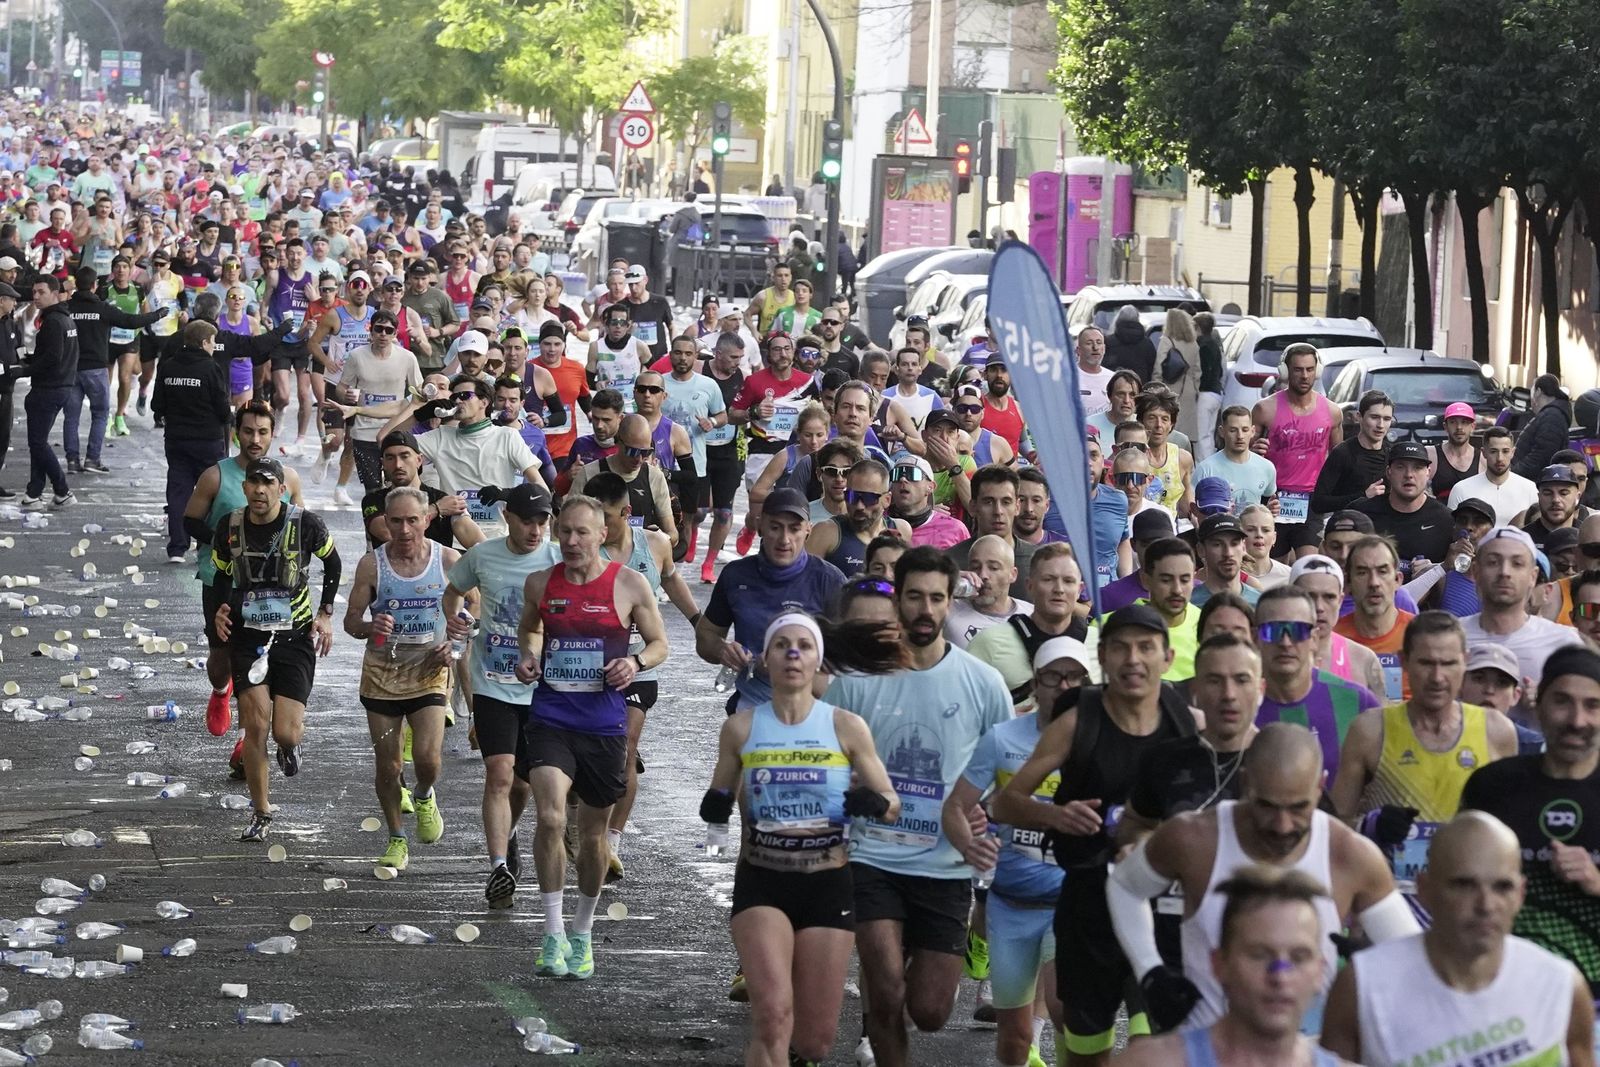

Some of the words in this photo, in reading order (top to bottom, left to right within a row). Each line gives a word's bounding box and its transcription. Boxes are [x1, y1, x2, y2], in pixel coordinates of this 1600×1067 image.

[626, 124, 647, 137] 30
[402, 599, 432, 608] ZURICH
[391, 621, 435, 633] ENJAMÍN
[562, 641, 597, 649] ZURICH
[564, 657, 582, 665] 5513
[545, 667, 603, 680] GRANADOS
[775, 771, 818, 782] ZURICH
[896, 781, 936, 796] ZURICH
[759, 802, 824, 819] CRISTINA
